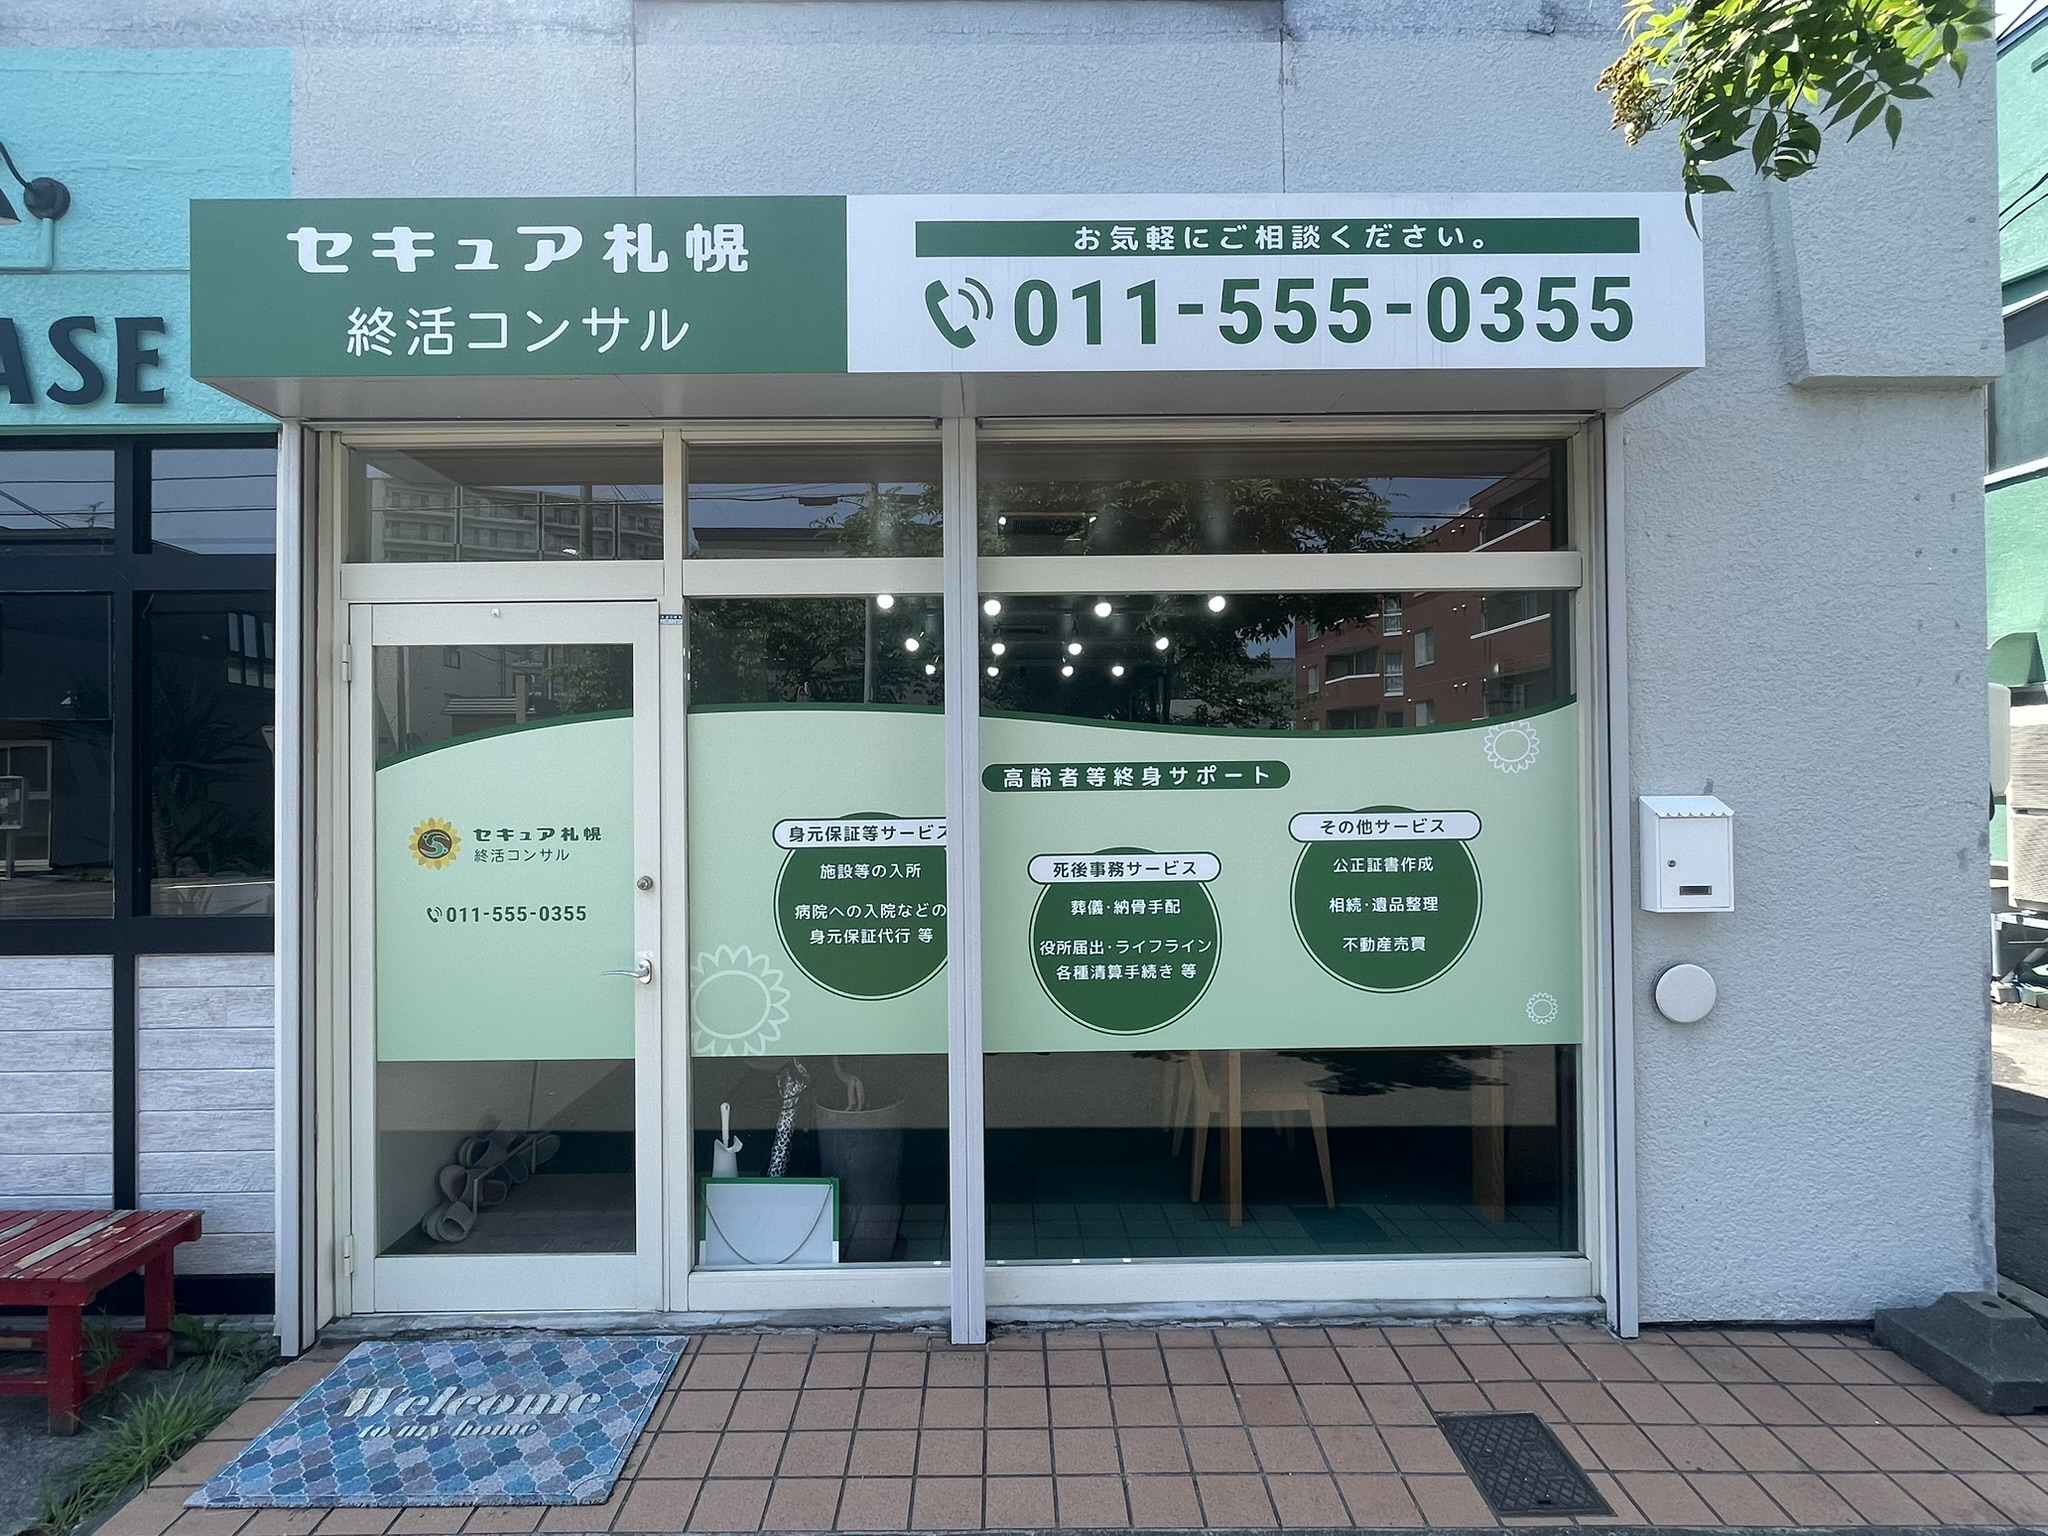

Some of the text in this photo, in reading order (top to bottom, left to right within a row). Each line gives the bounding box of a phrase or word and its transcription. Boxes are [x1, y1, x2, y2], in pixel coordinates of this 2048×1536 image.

[1073, 223, 1489, 253] お気軽にご相談ください。
[286, 222, 750, 274] セキュア札幌
[1013, 276, 1634, 347] 011-555-0355
[346, 306, 690, 357] 終活コンサル
[1003, 765, 1270, 789] 高齢者等終身サポート
[472, 826, 602, 842] セキュア札幌
[1320, 818, 1445, 836] その他サービス
[473, 848, 570, 863] 終活コンサル
[1333, 856, 1434, 873] 公正証書作成
[819, 863, 922, 880] 施設等の入所
[1053, 860, 1197, 878] 死後事務サービス
[794, 902, 947, 920] 病院への入院などの
[1070, 898, 1181, 916] 葬儀・納骨手配
[1328, 896, 1439, 913] 相続・遺品整理
[446, 905, 587, 923] 011-555-0355
[809, 927, 934, 945] 身元保証代行 等
[1342, 936, 1426, 953] 不動産売買
[1039, 939, 1212, 956] 役所届出・ライフライン
[1056, 962, 1197, 981] 各種清算手続き 等
[343, 1386, 603, 1418] Welcome
[359, 1419, 541, 1440] to my home
